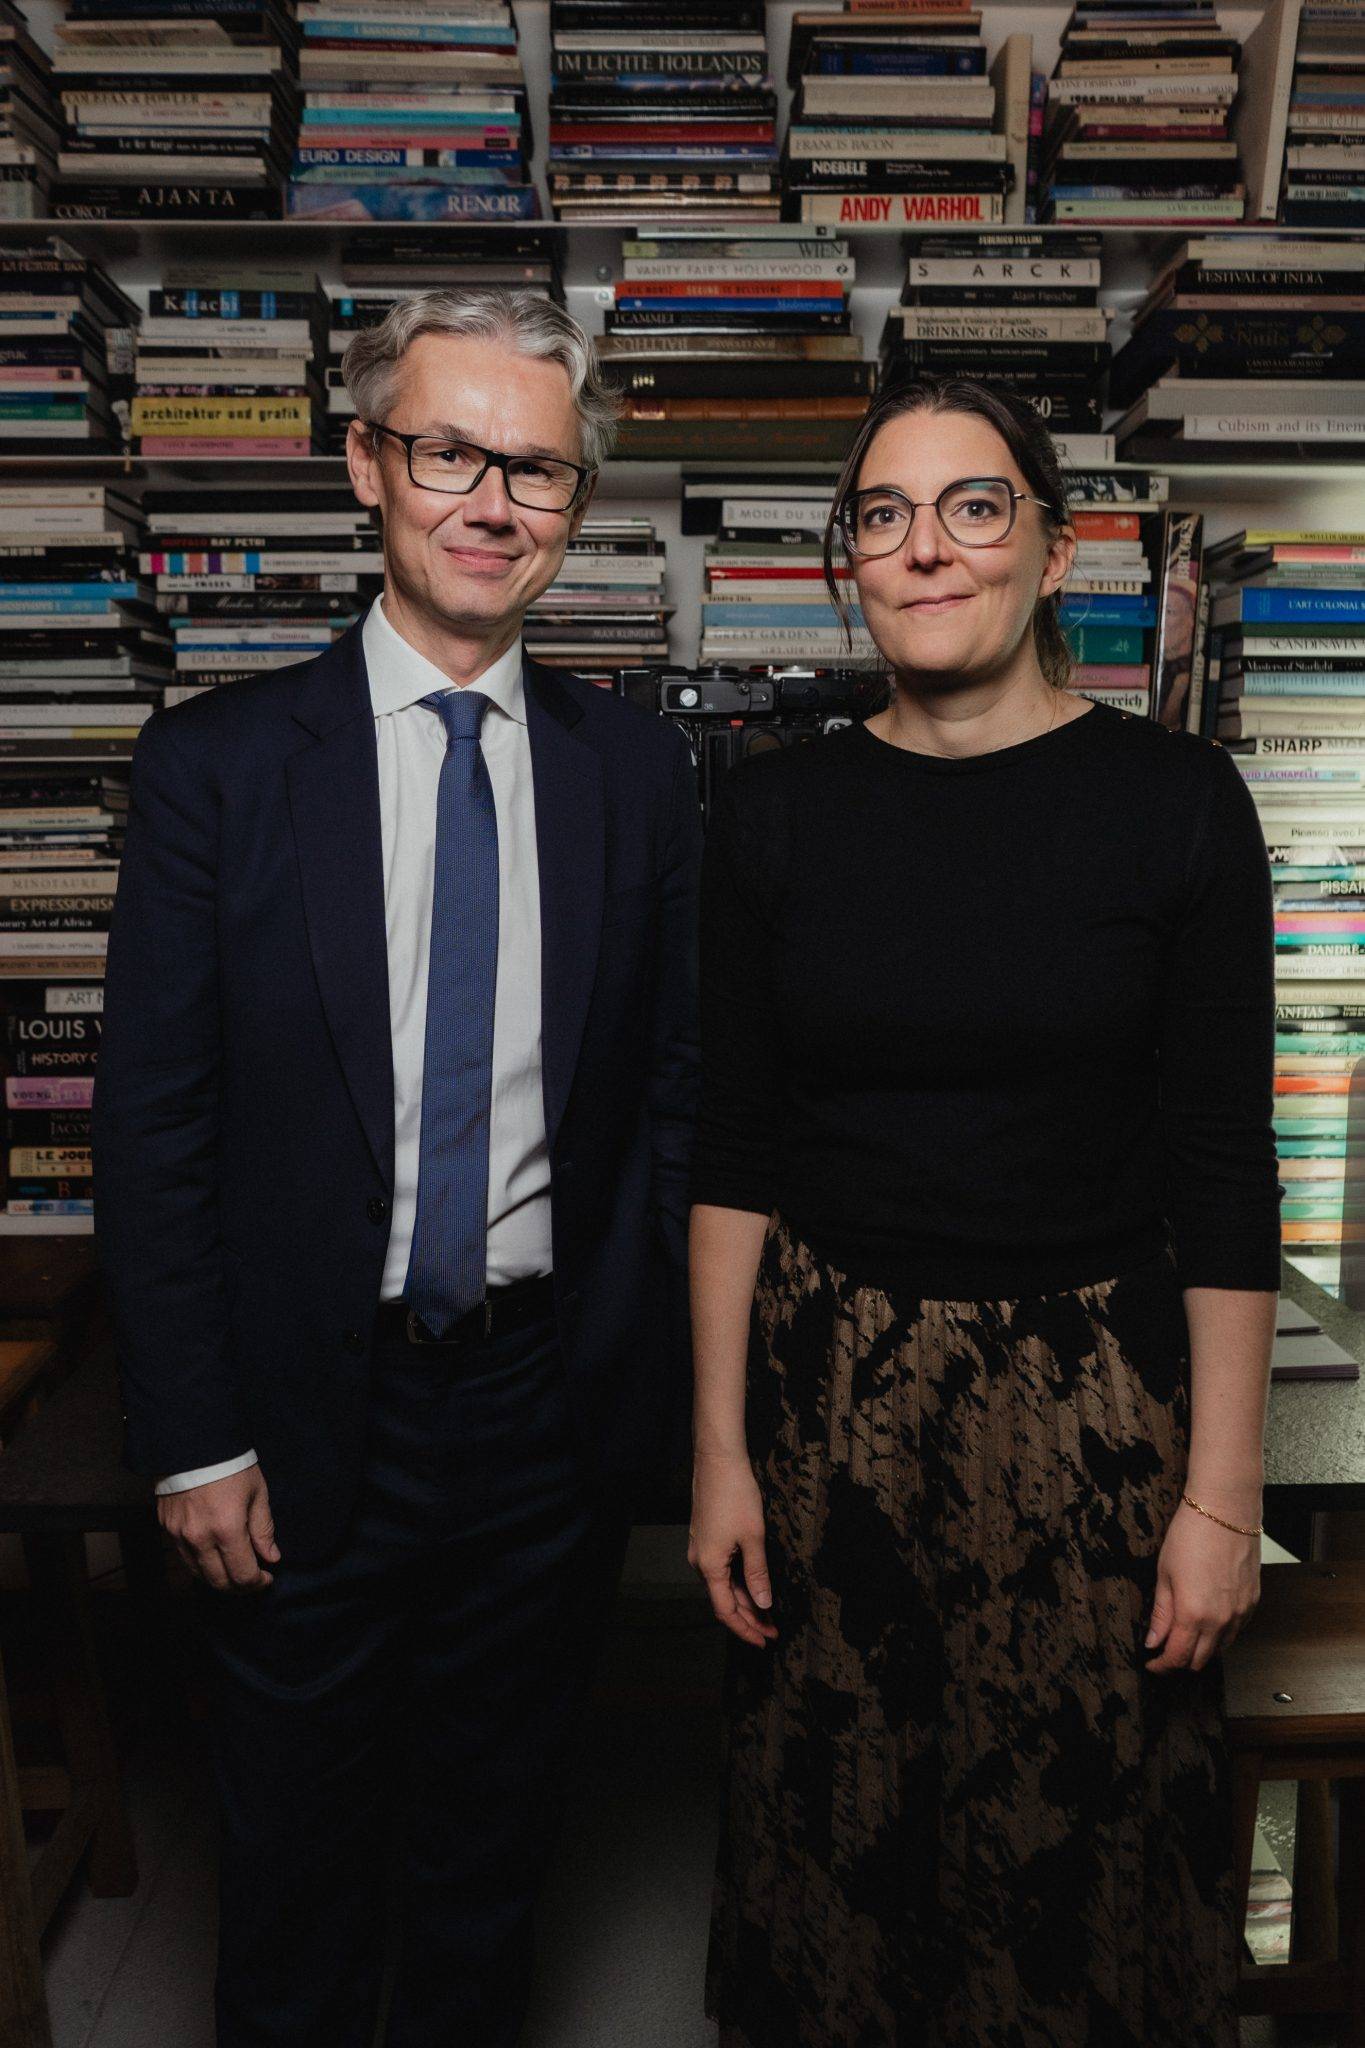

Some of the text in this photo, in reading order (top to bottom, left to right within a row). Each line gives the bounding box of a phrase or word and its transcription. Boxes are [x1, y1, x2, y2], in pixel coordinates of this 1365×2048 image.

[557, 54, 762, 72] IM LICHTE HOLLANDS
[299, 149, 401, 165] EURO DESIGN
[810, 160, 868, 177] NDEBELE
[137, 187, 237, 207] AJANTA
[447, 194, 521, 213] RENOIR
[840, 197, 984, 222] ANDY WARHOL
[798, 241, 845, 258] WIEN
[636, 264, 823, 278] VANITY FAIR'S HOLLYWOOD
[1197, 270, 1324, 284] FESTIVAL OF INDIA
[916, 326, 1049, 340] DRINKING GLASSES
[613, 338, 689, 351] BALTHUS
[142, 407, 300, 423] architektur und grafik
[1217, 419, 1270, 433] Cubism
[1275, 419, 1300, 433] and
[1305, 419, 1322, 433] its
[740, 509, 777, 521] MODE
[784, 509, 804, 521] DU
[1089, 580, 1137, 592] CULTES
[1317, 599, 1358, 611] COLONIAL
[759, 628, 819, 640] GARDENS
[1269, 638, 1357, 650] SCANDINAVIA
[1262, 739, 1322, 753] SHARP
[1264, 770, 1321, 779] LACHAPELLE
[12, 876, 99, 890] MINOTAURE
[31, 917, 48, 928] Art
[49, 917, 60, 928] of
[62, 917, 93, 928] Africa
[64, 992, 92, 1006] ART
[1276, 1005, 1325, 1019] ANITAS
[18, 1019, 87, 1040] LOUIS
[31, 1051, 89, 1067] HISTORY
[36, 1150, 54, 1161] LE
